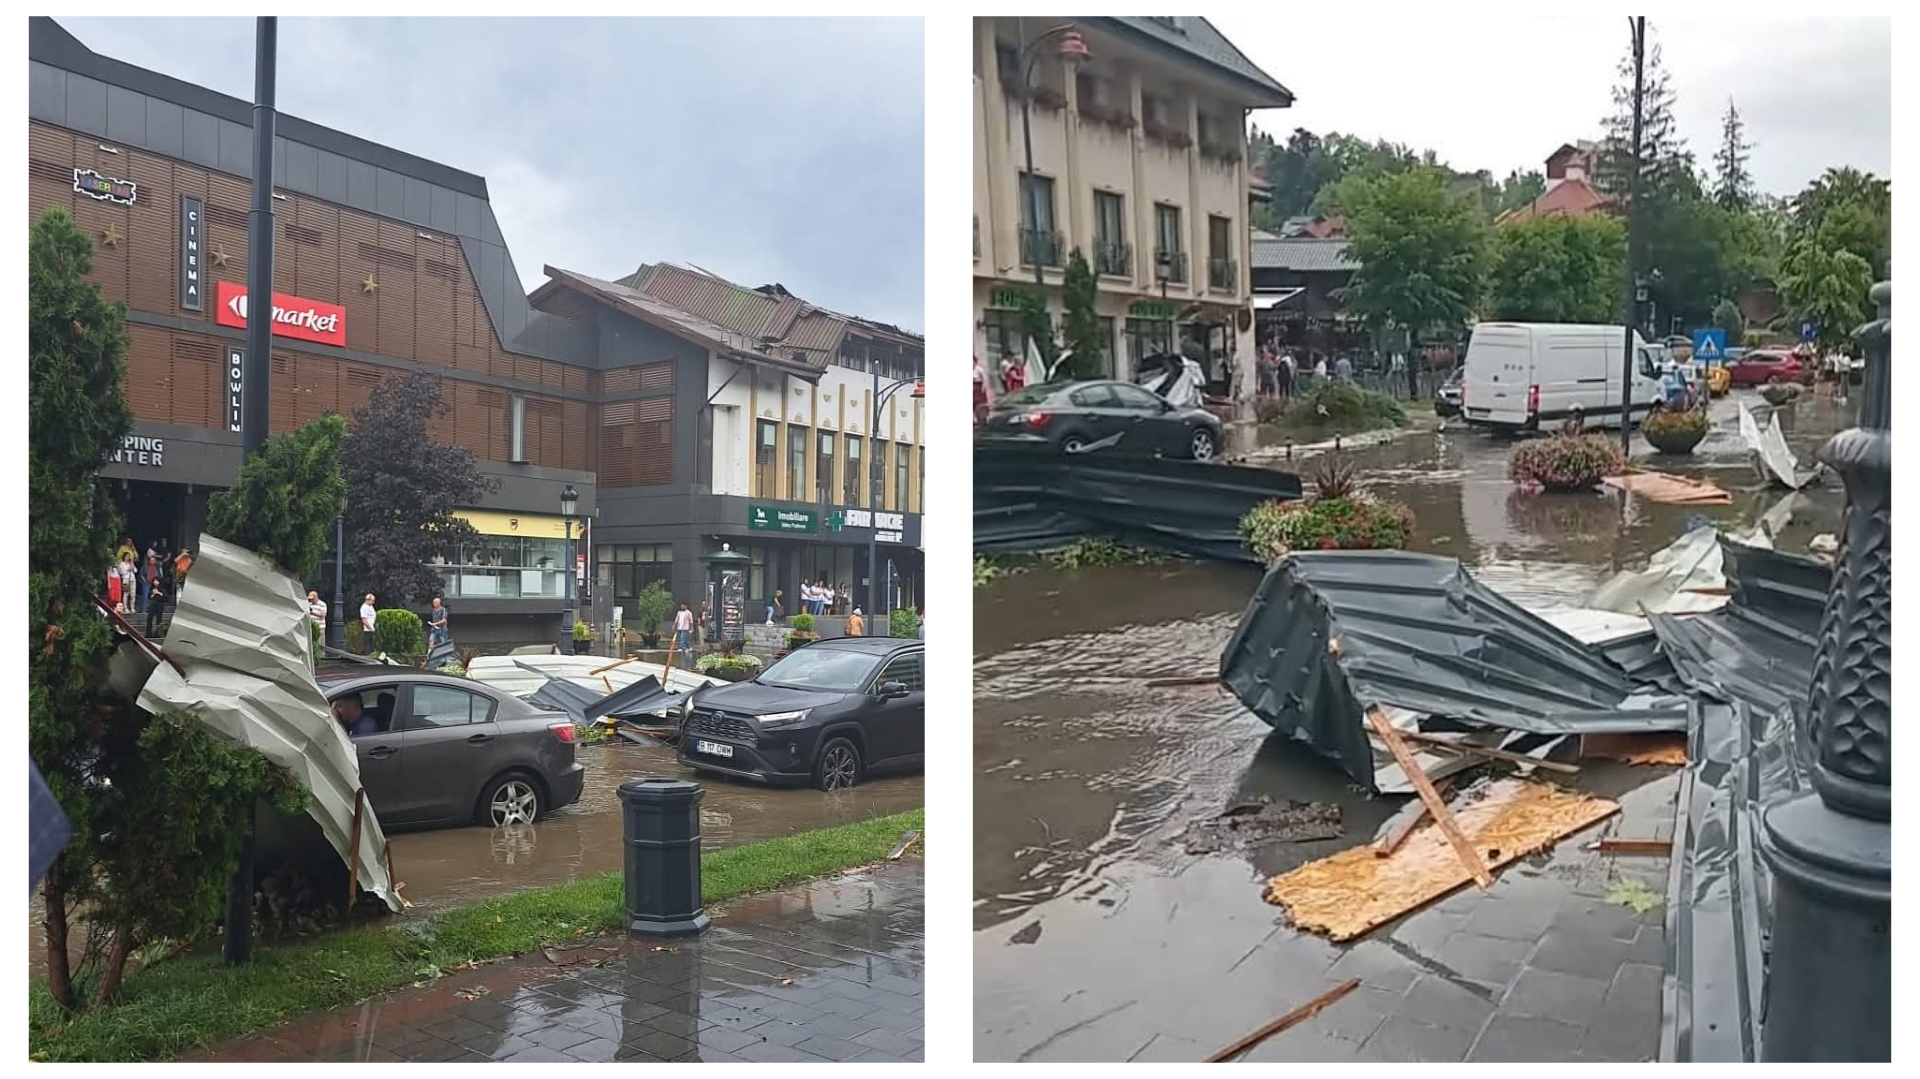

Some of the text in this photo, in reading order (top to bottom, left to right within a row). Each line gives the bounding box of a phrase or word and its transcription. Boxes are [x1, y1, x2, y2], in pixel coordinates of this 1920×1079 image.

[188, 212, 197, 295] CINEMA
[271, 306, 339, 332] market
[102, 448, 163, 466] NTER
[777, 510, 809, 522] Imobiliare
